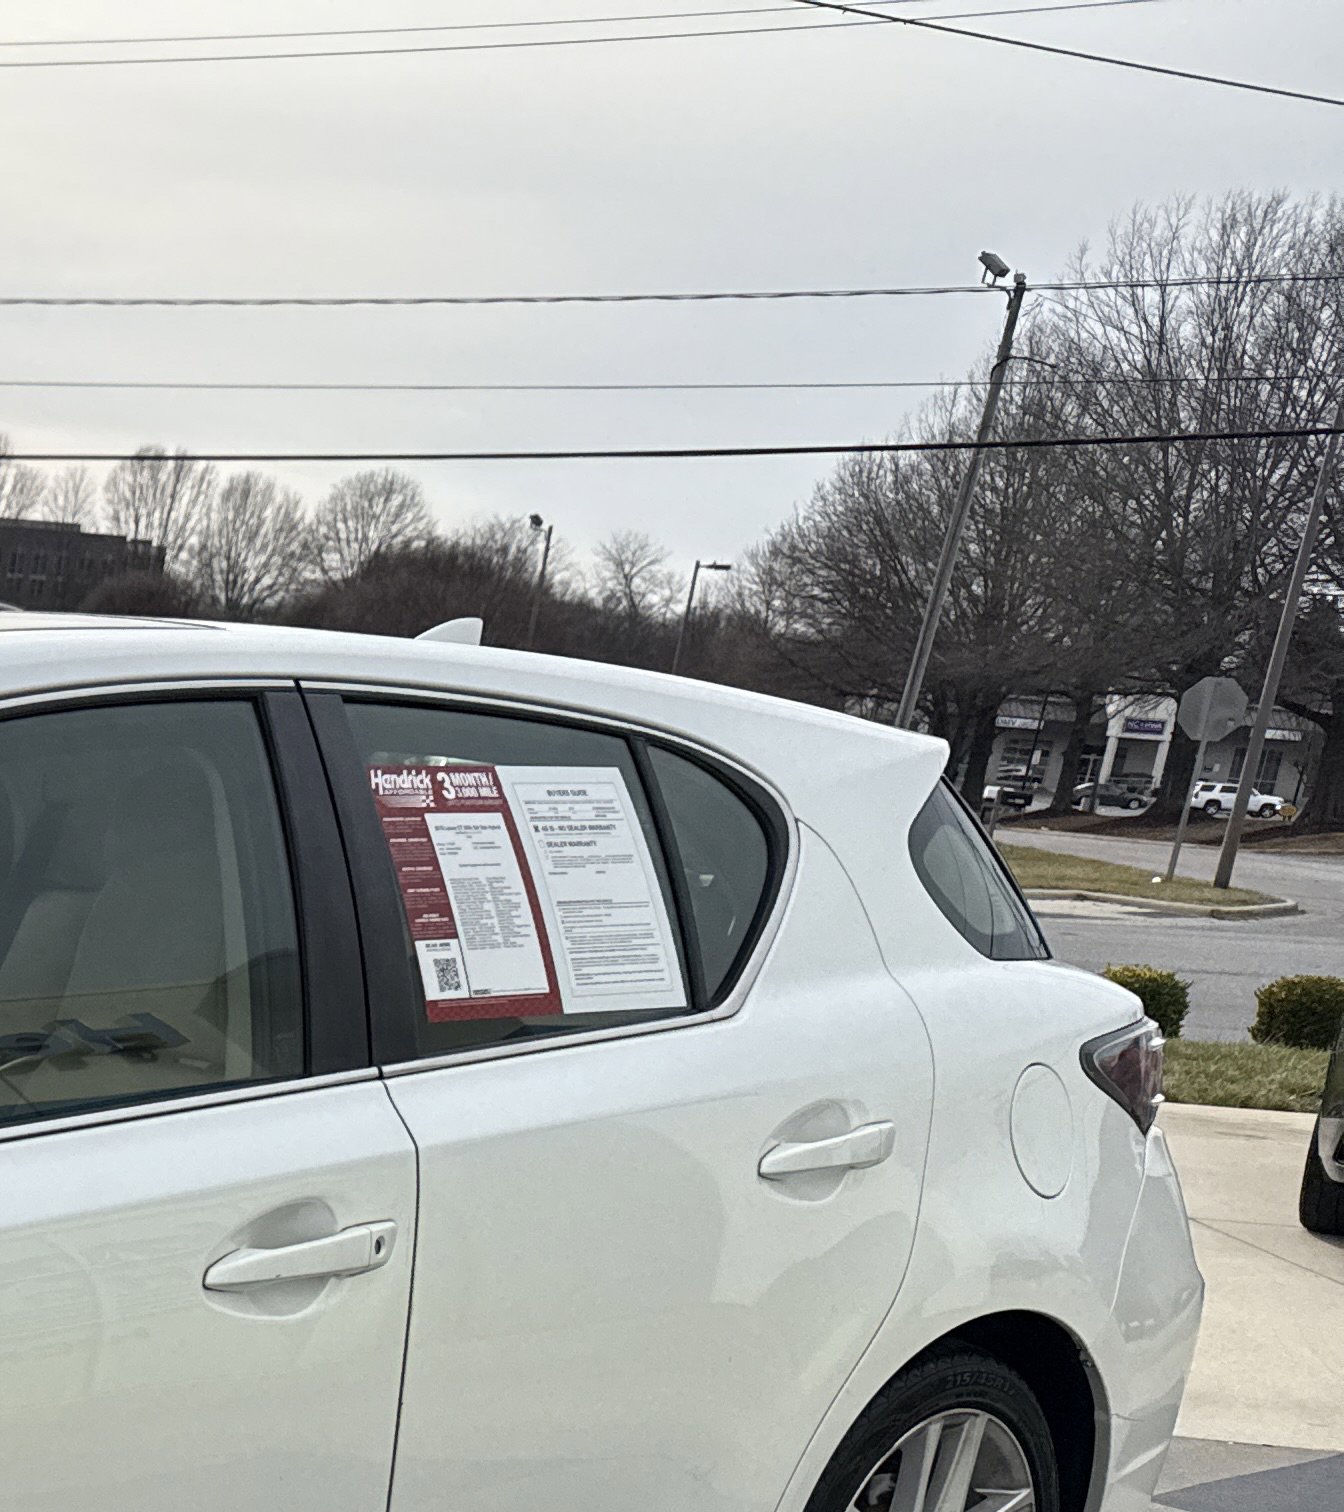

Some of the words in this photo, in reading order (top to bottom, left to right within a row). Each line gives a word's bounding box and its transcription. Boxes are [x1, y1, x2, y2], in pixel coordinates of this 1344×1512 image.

[370, 769, 433, 795] Hendrick
[436, 771, 457, 800] 3
[478, 786, 500, 798] MILE
[569, 789, 589, 797] GUIDE
[588, 823, 616, 831] WARRANTY
[546, 841, 568, 849] DEALER
[568, 840, 597, 848] WARRANTY
